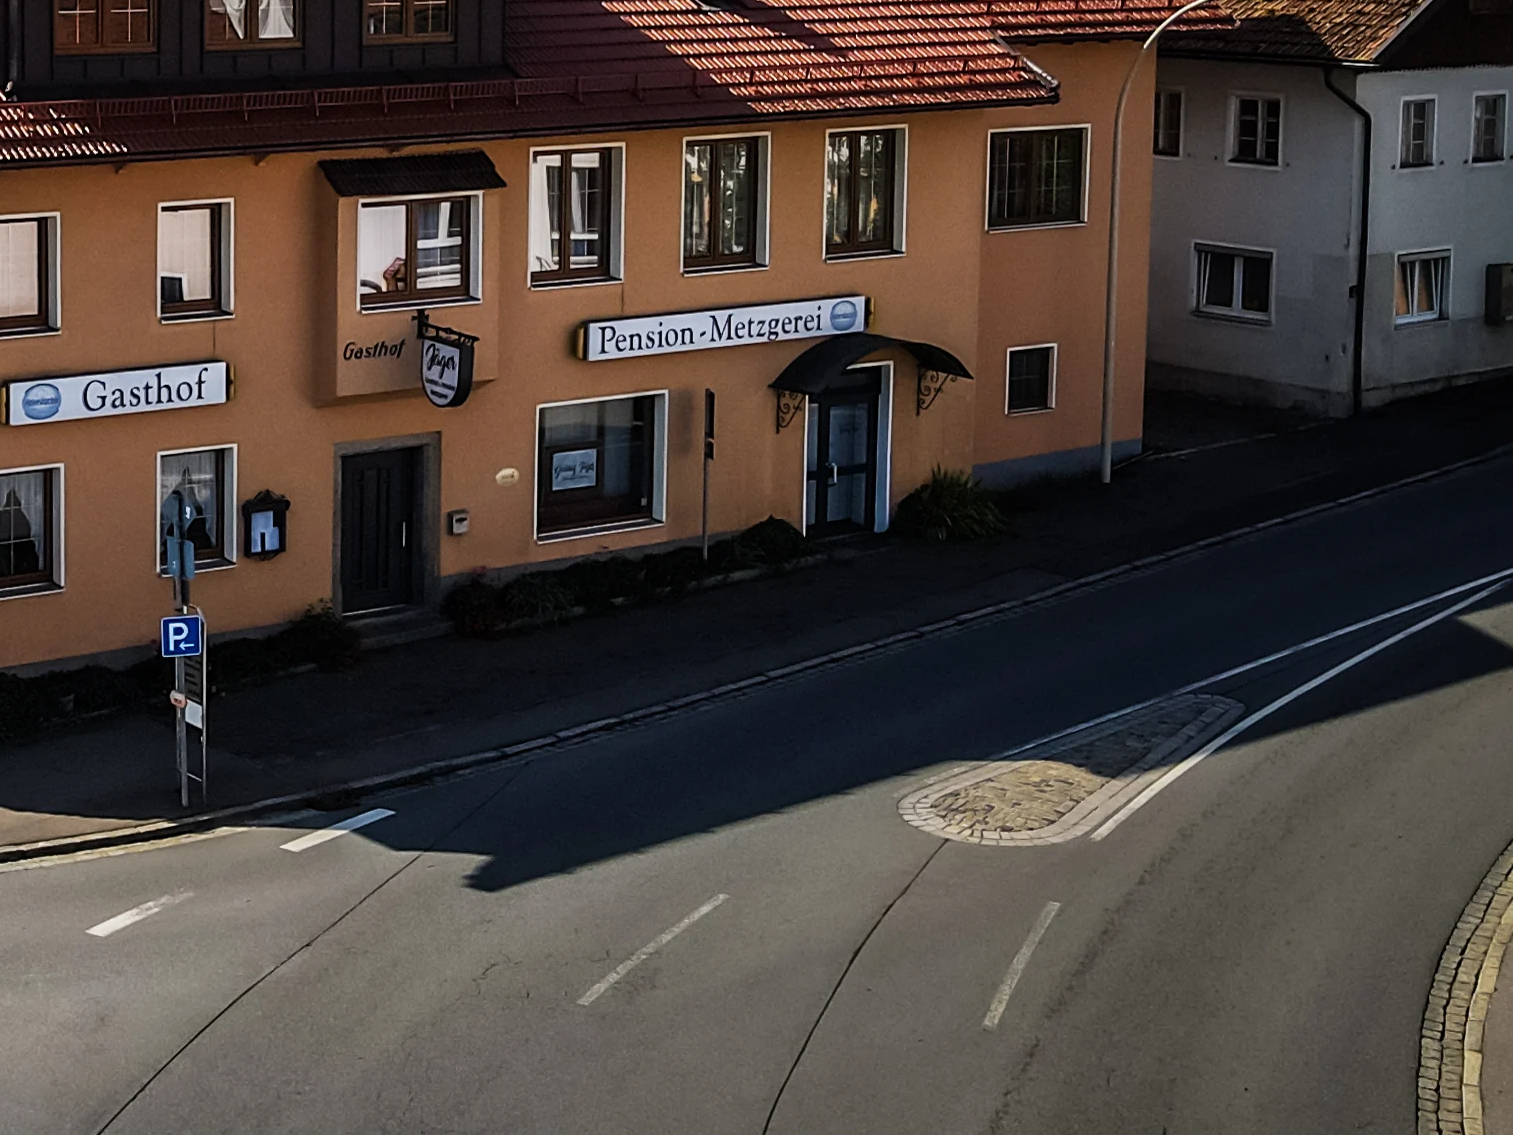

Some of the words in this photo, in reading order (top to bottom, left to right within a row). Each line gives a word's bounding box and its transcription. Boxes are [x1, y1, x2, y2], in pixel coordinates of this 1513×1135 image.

[343, 339, 405, 361] Gasthof
[425, 343, 456, 379] Jäger
[82, 367, 209, 412] Gasthof
[168, 623, 188, 651] P
